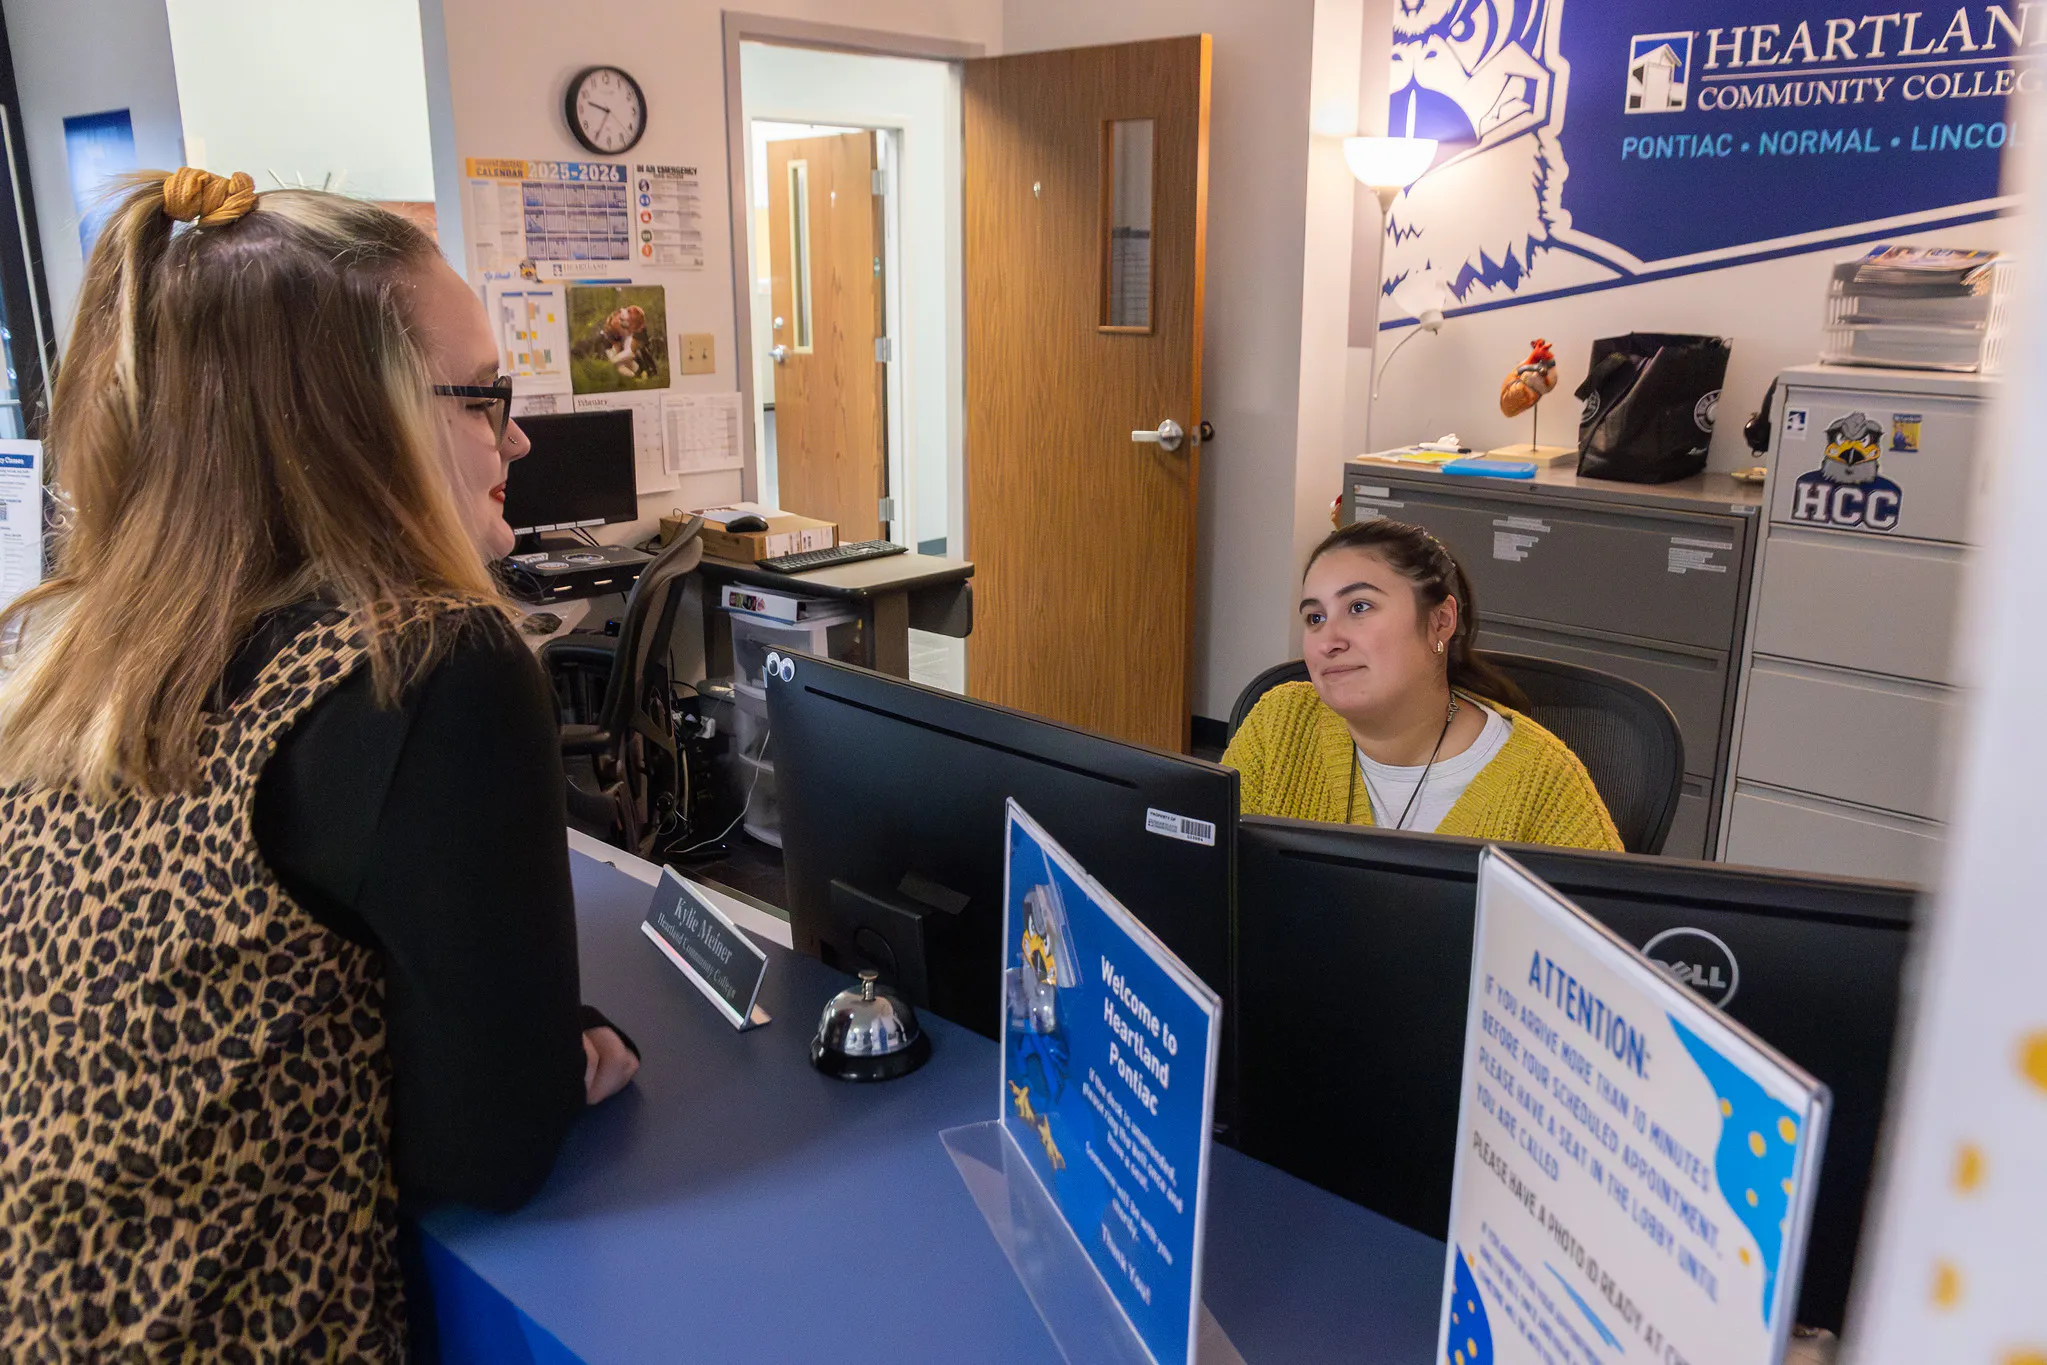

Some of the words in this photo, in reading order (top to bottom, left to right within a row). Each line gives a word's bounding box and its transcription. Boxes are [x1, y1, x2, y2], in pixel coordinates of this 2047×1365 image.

[1697, 77, 1894, 112] COMMUNITY
[1902, 68, 2044, 101] COLLEG
[527, 161, 620, 181] 2025-2026
[1621, 133, 1733, 161] PONTIAC
[1759, 127, 1881, 157] NORMAL
[1910, 121, 2025, 153] LINCOL
[1794, 482, 1899, 529] HCC
[674, 897, 699, 933] Kylie
[1101, 954, 1160, 1038] Welcome
[1162, 1021, 1178, 1057] to
[1104, 997, 1170, 1090] Heartland
[1528, 949, 1651, 1082] ATTENTION:
[1109, 1041, 1159, 1117] Pontiac
[1481, 1009, 1520, 1062] BEFORE
[1521, 1046, 1550, 1090] YOUR
[1551, 1075, 1620, 1156] SCHEDULED
[1484, 973, 1495, 996] IF
[1496, 983, 1518, 1017] YOU
[1520, 1004, 1560, 1055] ARRIVE
[1560, 1040, 1594, 1087] MORE
[1596, 1072, 1630, 1121] THAN
[1650, 1120, 1711, 1194] MINUTES
[1476, 1081, 1497, 1116] YOU
[1497, 1104, 1517, 1141] ARE
[1519, 1127, 1560, 1183] CALLED
[1478, 1045, 1515, 1099] PLEASE
[1516, 1083, 1546, 1129] HAVE
[1546, 1114, 1556, 1138] A
[1559, 1124, 1588, 1170] SEAT
[1590, 1156, 1603, 1187] IN
[1607, 1170, 1631, 1214] THE
[1631, 1196, 1675, 1256] LOBBY
[1472, 1129, 1508, 1186] PLEASE
[1508, 1170, 1537, 1218] HAVE
[1537, 1203, 1546, 1228] A
[1547, 1212, 1586, 1271] PHOTO
[1585, 1256, 1598, 1285] ID
[1600, 1270, 1645, 1333] READY
[1644, 1323, 1665, 1356] AT
